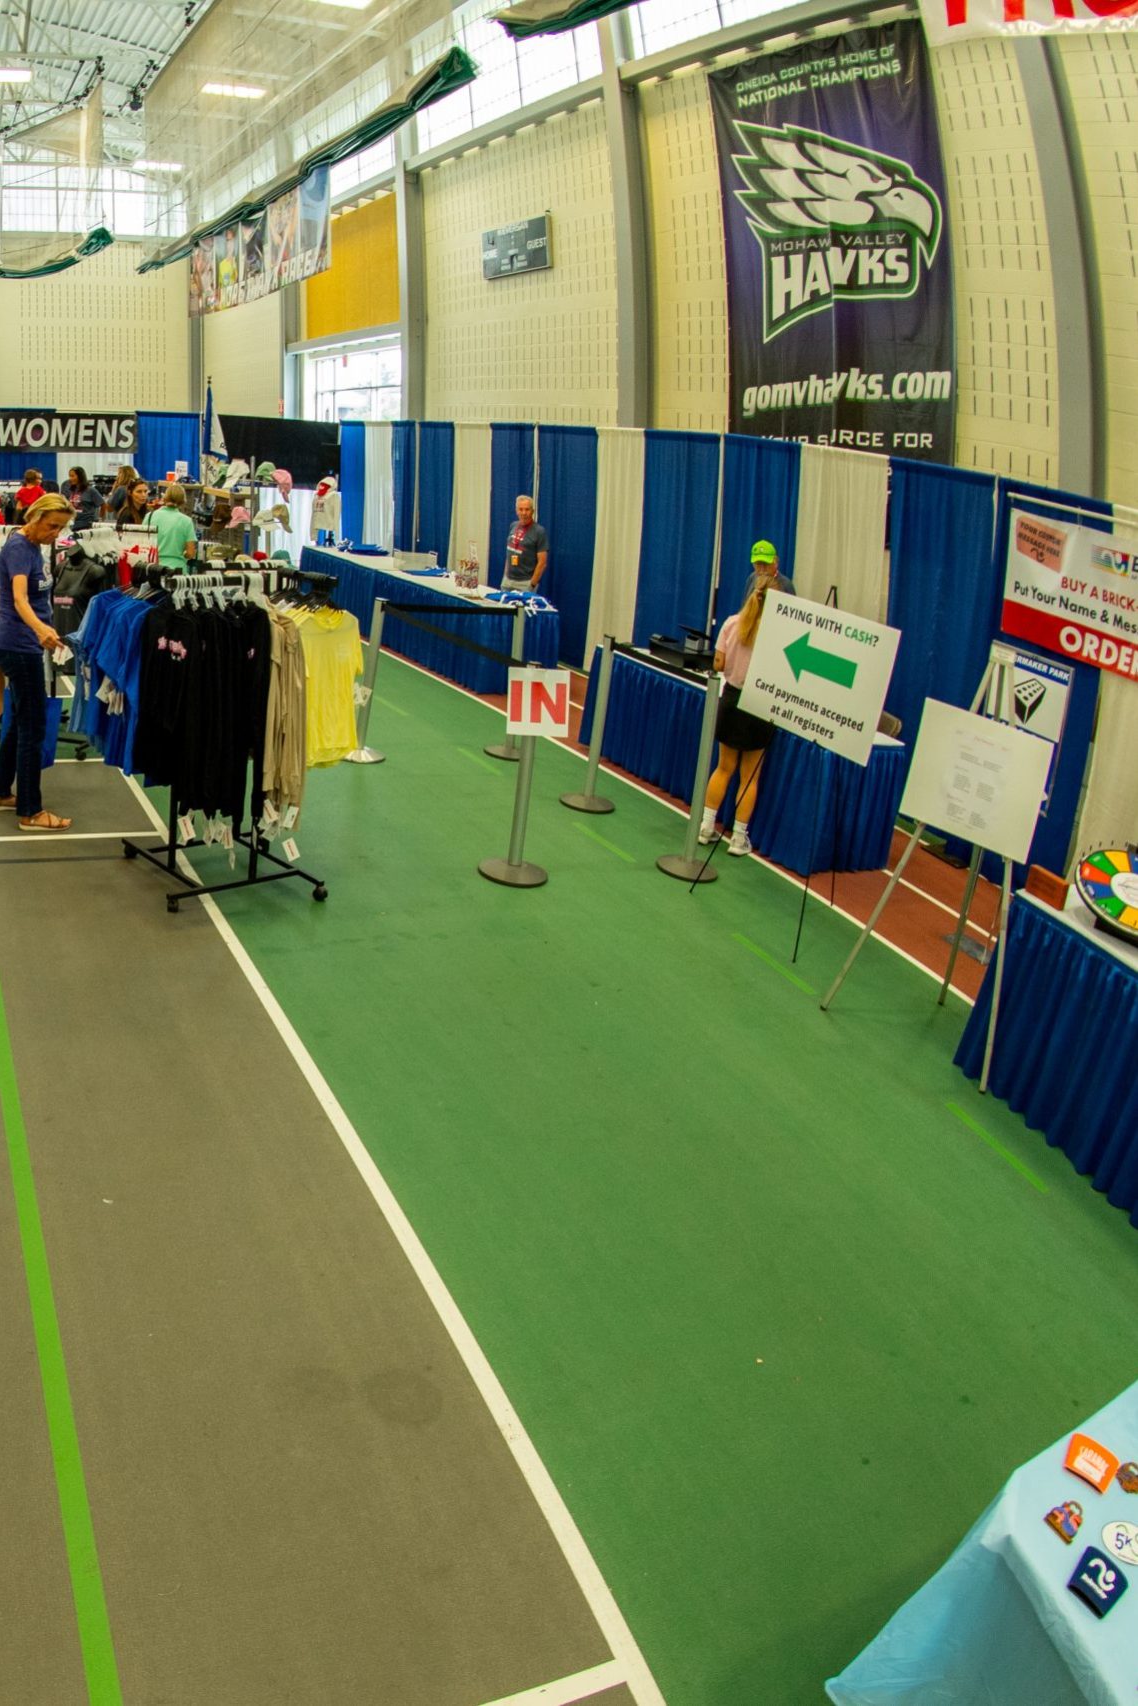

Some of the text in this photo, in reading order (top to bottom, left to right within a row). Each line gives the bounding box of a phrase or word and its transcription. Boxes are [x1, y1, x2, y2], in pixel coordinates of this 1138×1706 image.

[736, 44, 895, 93] ONEIDA COUNTY'S HOME OF
[737, 59, 901, 108] NATIONAL CHAMPIONS
[840, 233, 905, 247] VALLEY
[893, 432, 933, 448] FOR
[1014, 580, 1029, 597] Put
[1031, 585, 1057, 607] Your
[1059, 595, 1097, 620] Name
[1100, 609, 1110, 624] &
[1061, 575, 1088, 596] BUY
[1089, 586, 1099, 600] A
[776, 602, 879, 648] PAYING WITH CASH?
[1059, 625, 1138, 676] ORDE
[1048, 664, 1071, 682] PARK
[510, 680, 567, 725] IN
[755, 678, 865, 733] Card payments accepted
[770, 705, 835, 740] at all registers
